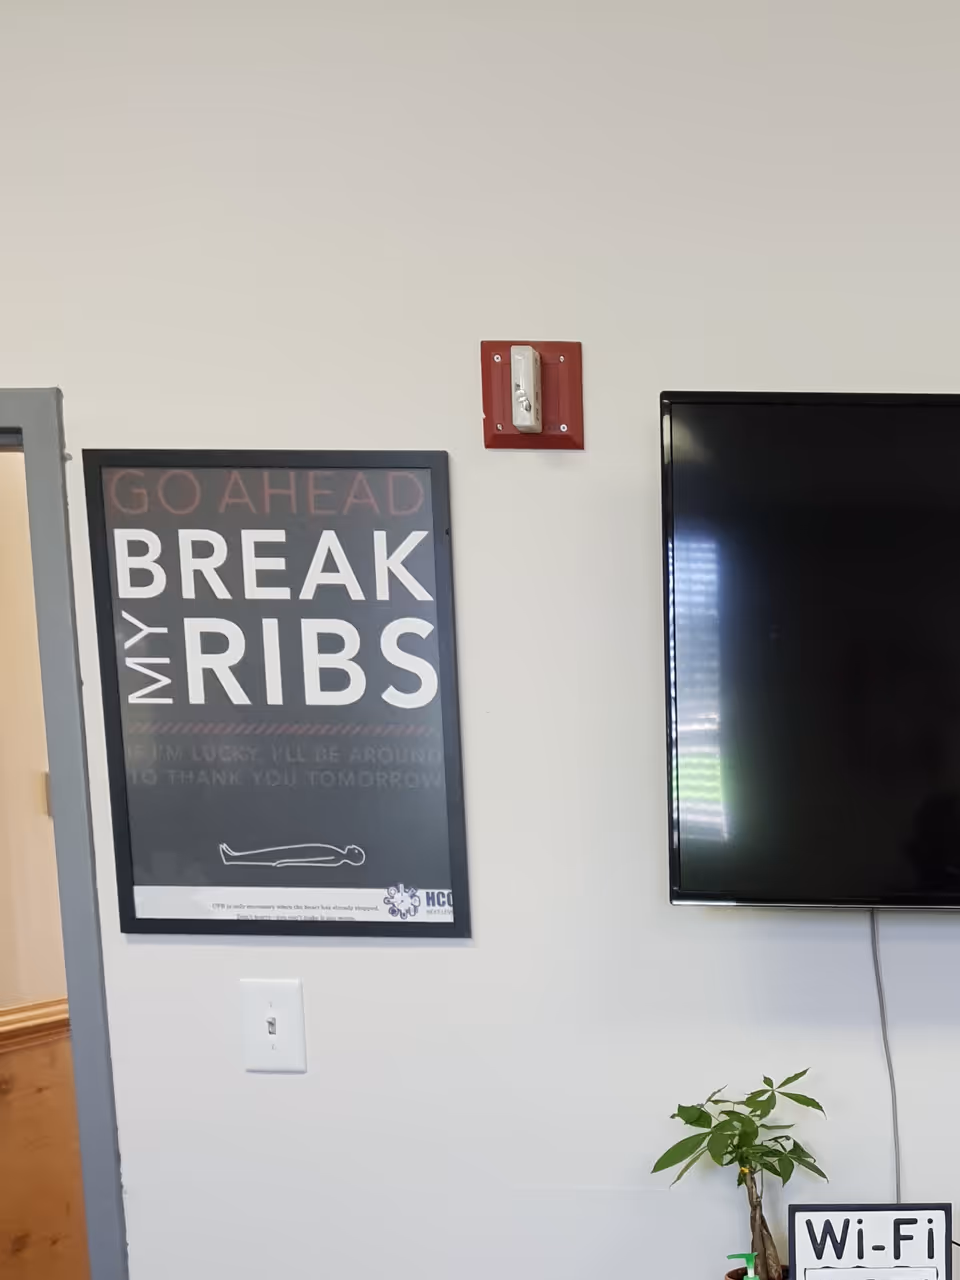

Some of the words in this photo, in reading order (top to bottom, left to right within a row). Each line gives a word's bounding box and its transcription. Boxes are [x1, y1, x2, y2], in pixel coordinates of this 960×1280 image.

[108, 470, 200, 515] GO
[219, 470, 425, 517] AHEAD
[113, 528, 434, 601] BREAK
[121, 610, 173, 705] MY
[183, 617, 438, 709] RIBS
[129, 768, 157, 786] TO
[167, 769, 242, 787] THANK
[252, 769, 297, 788] YOU
[315, 747, 341, 763] BE
[805, 1218, 935, 1260] Wi-Fi
